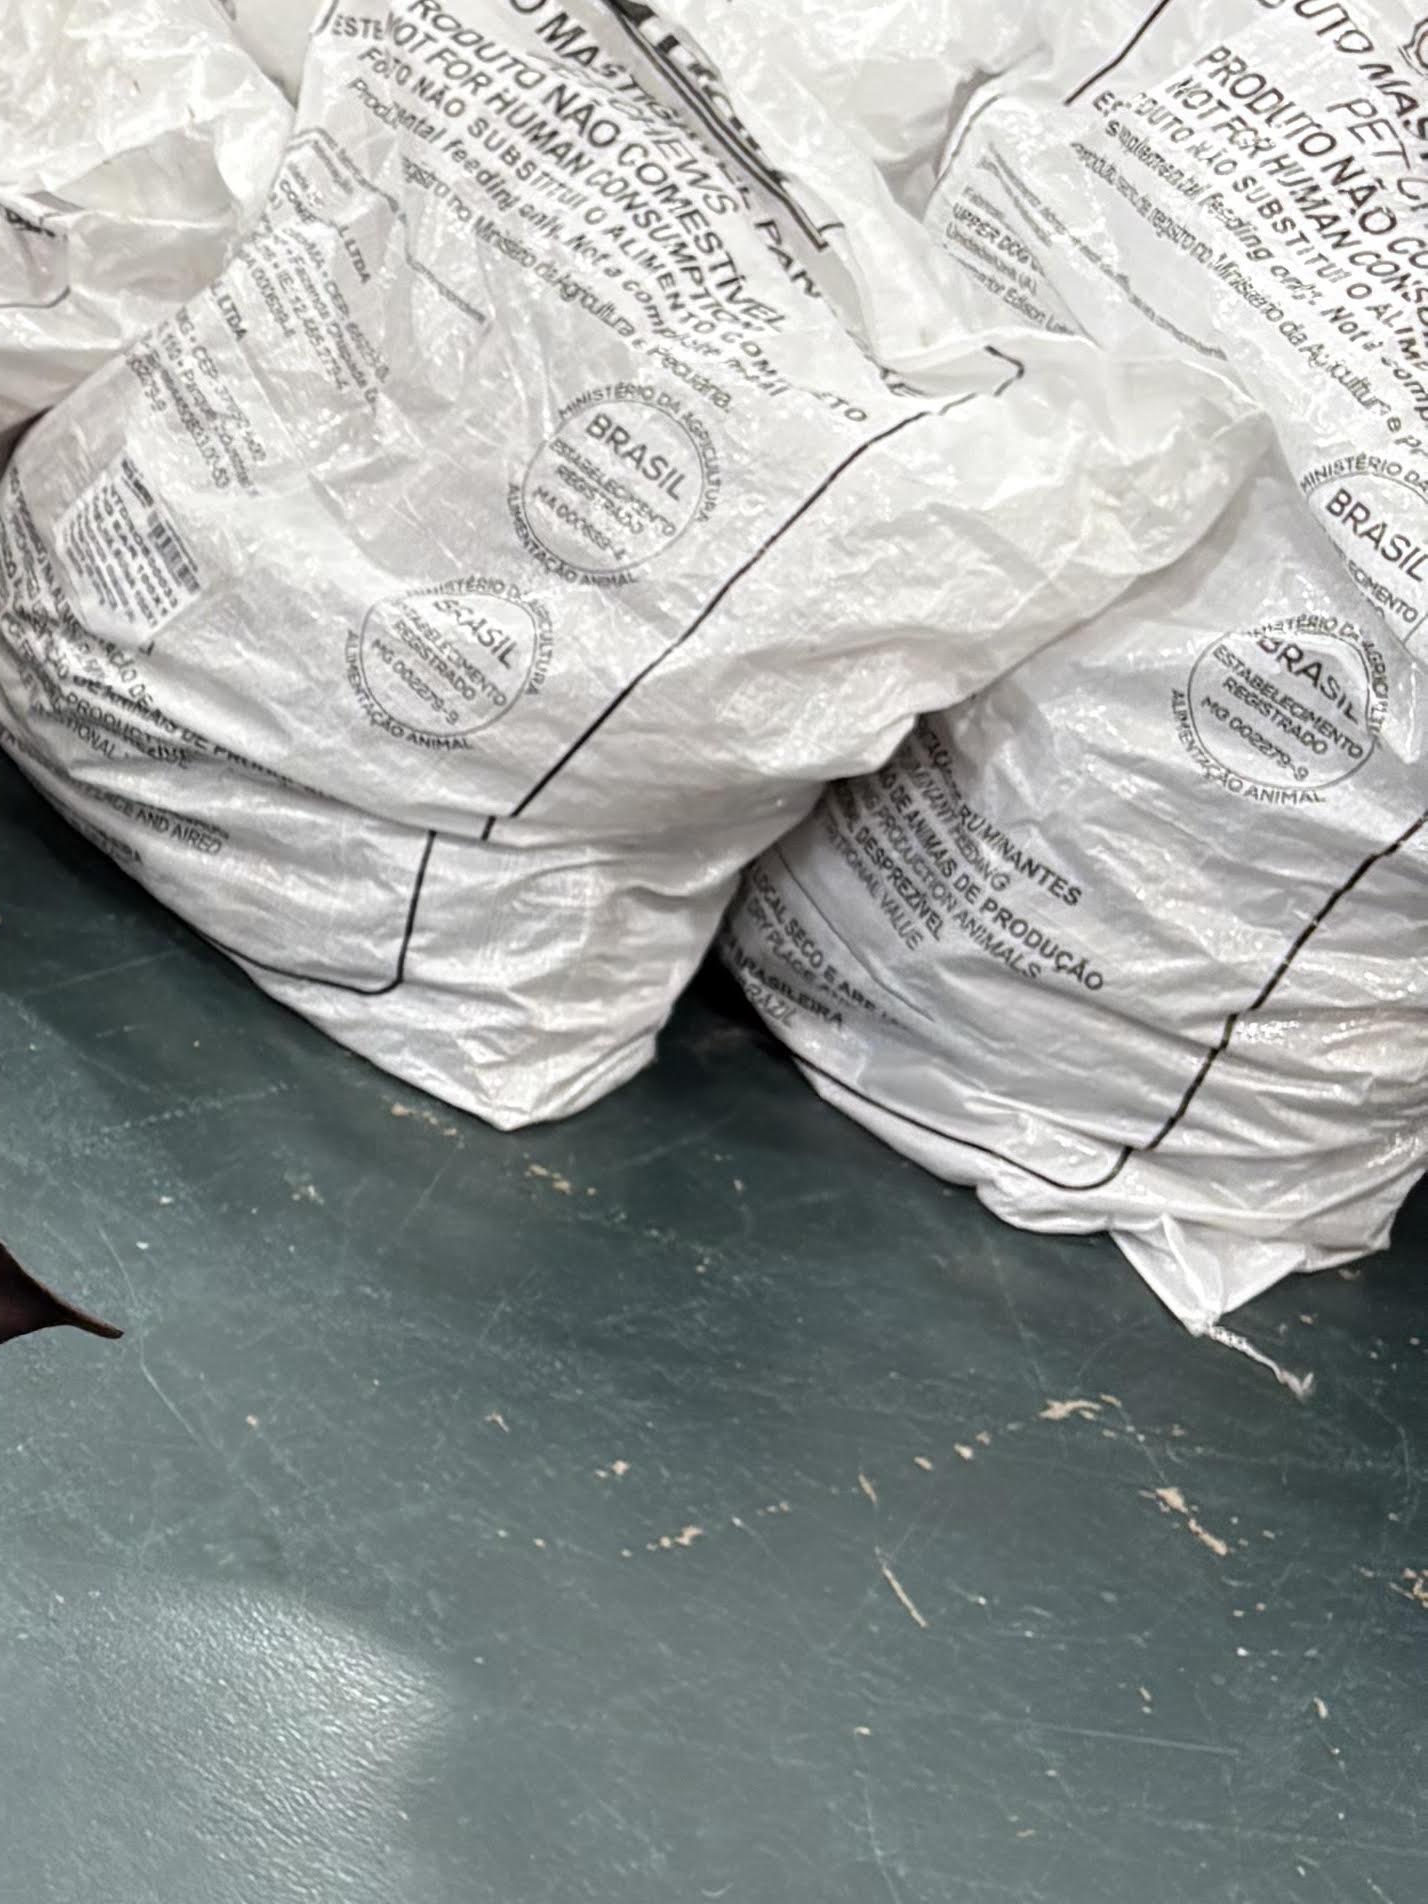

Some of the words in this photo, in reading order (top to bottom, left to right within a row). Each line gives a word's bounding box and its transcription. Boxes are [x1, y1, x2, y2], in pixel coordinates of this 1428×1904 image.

[424, 46, 494, 97] FOR
[485, 87, 594, 178] HUMAN
[1196, 43, 1338, 158] PRODUTO
[1319, 154, 1400, 238] NÃO
[1326, 96, 1412, 172] PET
[1164, 76, 1232, 122] NOT
[1211, 114, 1278, 161] FOR
[1259, 151, 1362, 251] HUMAN
[410, 75, 467, 119] NÃO
[466, 115, 588, 208] SUBSTITUI
[583, 206, 611, 227] O
[602, 225, 717, 336] ALIMENTO
[546, 82, 622, 149] NÃO
[616, 142, 786, 333] COMESTÍVEL
[1232, 174, 1351, 283] SUBSTITUI
[1346, 282, 1373, 300] O
[345, 237, 371, 284] LTDA
[216, 292, 248, 342] LTDA
[1278, 320, 1309, 348] da
[557, 381, 656, 421] MINISTÉRIO
[657, 391, 683, 415] DA
[585, 412, 687, 503] BRASIL
[1299, 451, 1403, 494] MINISTÉRIO
[1325, 487, 1428, 583] BRASIL
[1200, 695, 1231, 723] MG
[1211, 643, 1365, 761] ESTABELECIMENTO
[1221, 675, 1329, 756] REGISTRADO
[1256, 636, 1360, 726] BRASIL
[405, 732, 475, 751] ANIMAL
[1243, 787, 1328, 805] ANIMAL
[170, 822, 224, 856] AIRED
[956, 803, 1083, 908] RUMINANTES
[854, 824, 946, 942] DESPREZÍVEL
[878, 890, 925, 953] VALUE
[905, 807, 958, 880] ANIMAIS
[951, 873, 983, 906] DE
[978, 895, 1105, 993] PRODUÇÃO
[784, 916, 824, 969] SECO
[823, 963, 839, 984] E
[952, 906, 1042, 981] ANIMALS
